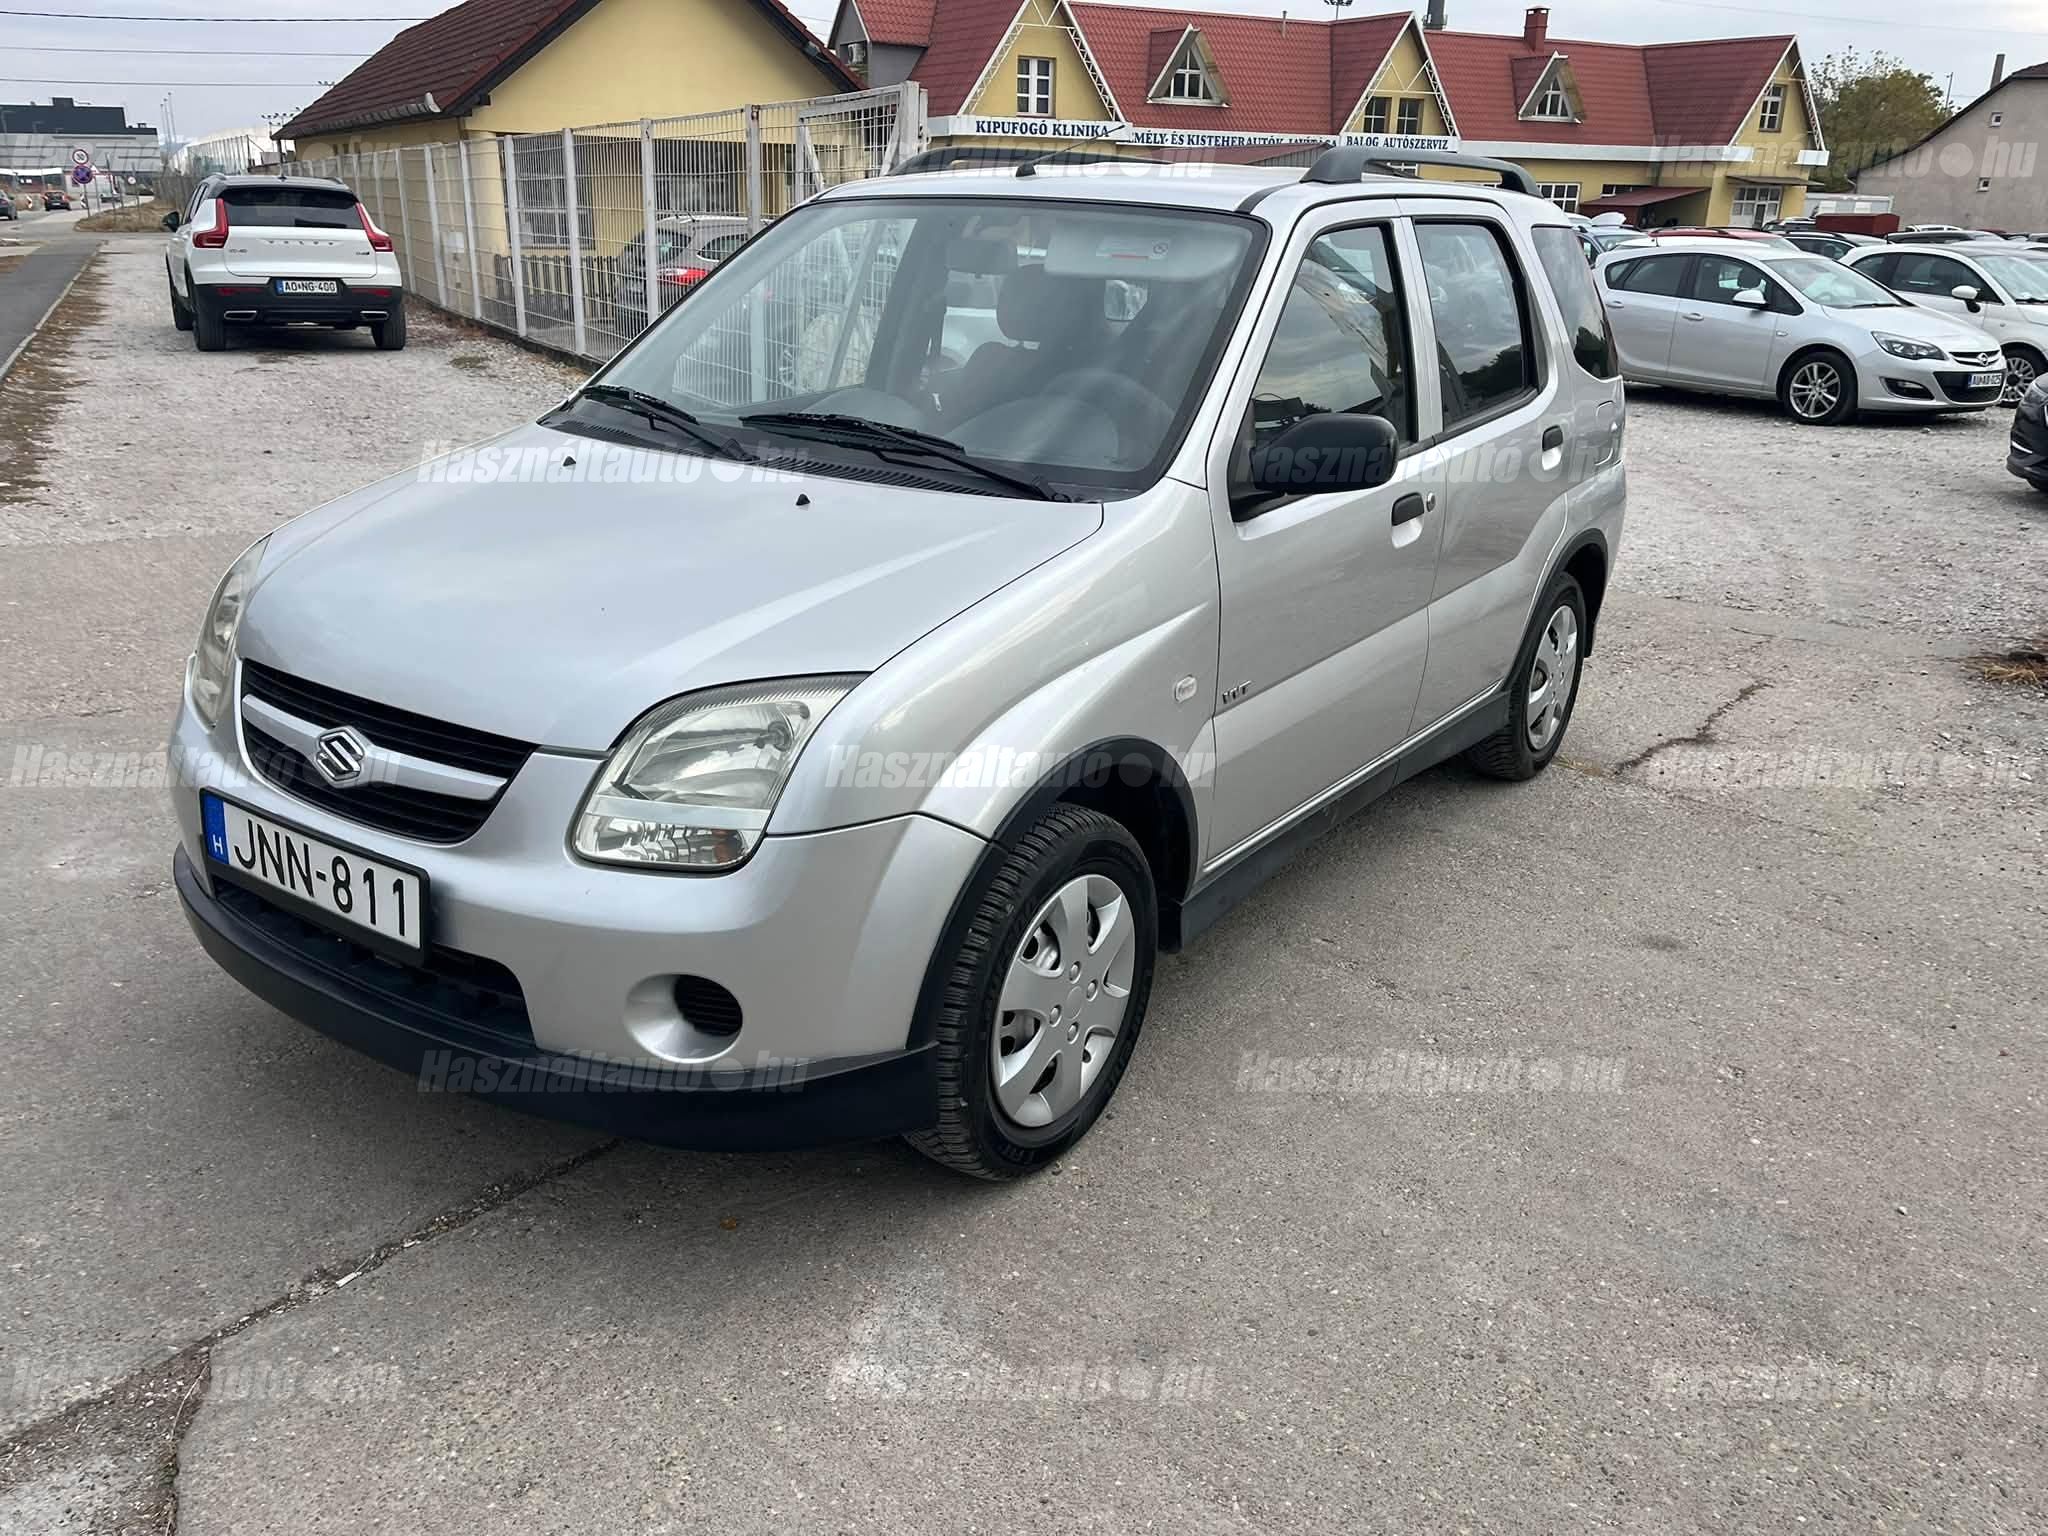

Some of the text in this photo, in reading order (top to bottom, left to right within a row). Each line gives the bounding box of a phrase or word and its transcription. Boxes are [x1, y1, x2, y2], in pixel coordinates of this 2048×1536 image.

[976, 120, 1110, 137] KIPUFOGÓ KLINIKA
[1129, 130, 1169, 144] MÉLY-
[1171, 131, 1185, 145] ÉS
[1346, 136, 1379, 147] BALOG
[1383, 136, 1449, 150] AUTÓSZERVIZ
[212, 834, 223, 855] H
[234, 819, 405, 937] JNN-811
